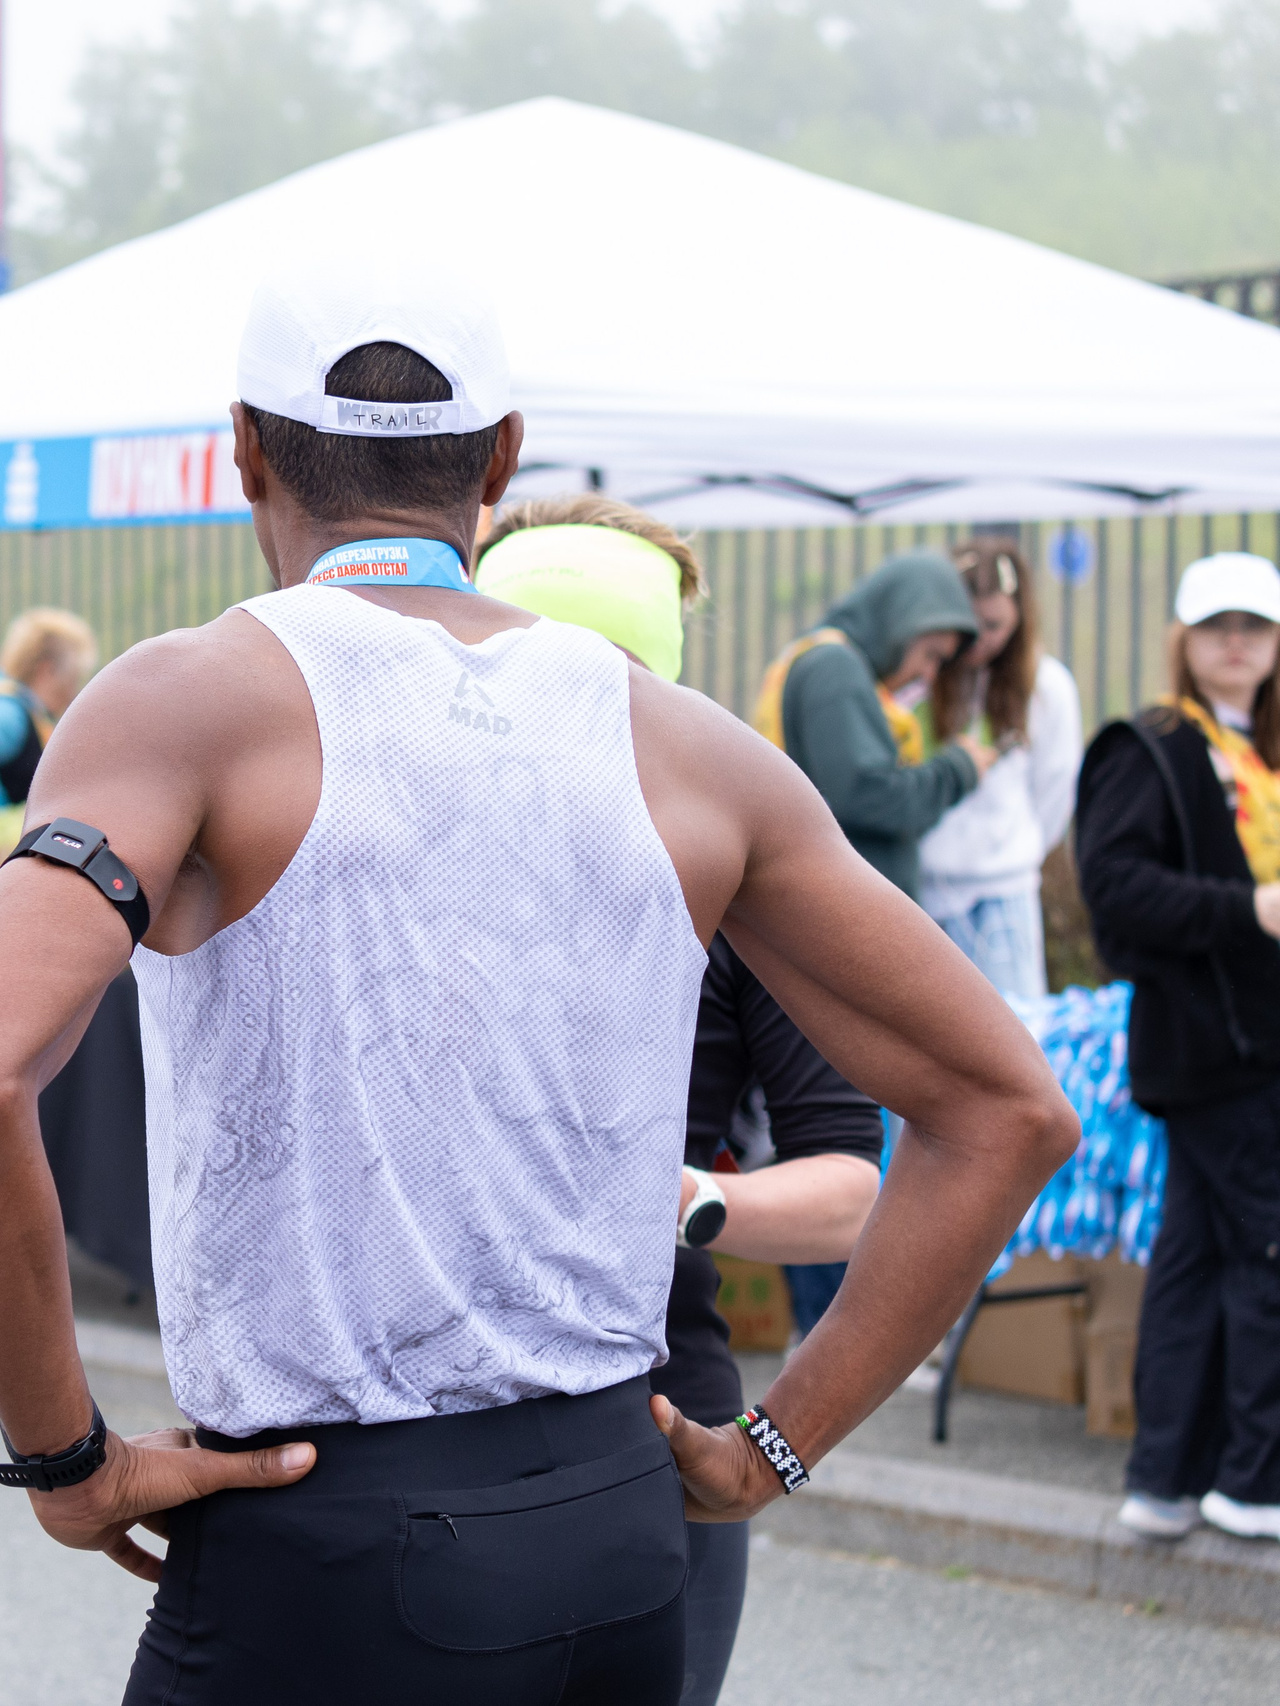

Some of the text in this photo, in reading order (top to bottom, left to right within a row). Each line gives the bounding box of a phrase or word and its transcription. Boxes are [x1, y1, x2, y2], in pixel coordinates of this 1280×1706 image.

[337, 401, 442, 431] WONDER
[336, 546, 409, 564] ПЕРЕЗАГРУЗКА
[307, 562, 408, 585] ТРЕСС ДАВНО ОТСТАЛ
[448, 702, 512, 735] MAD
[53, 836, 82, 849] POLAR
